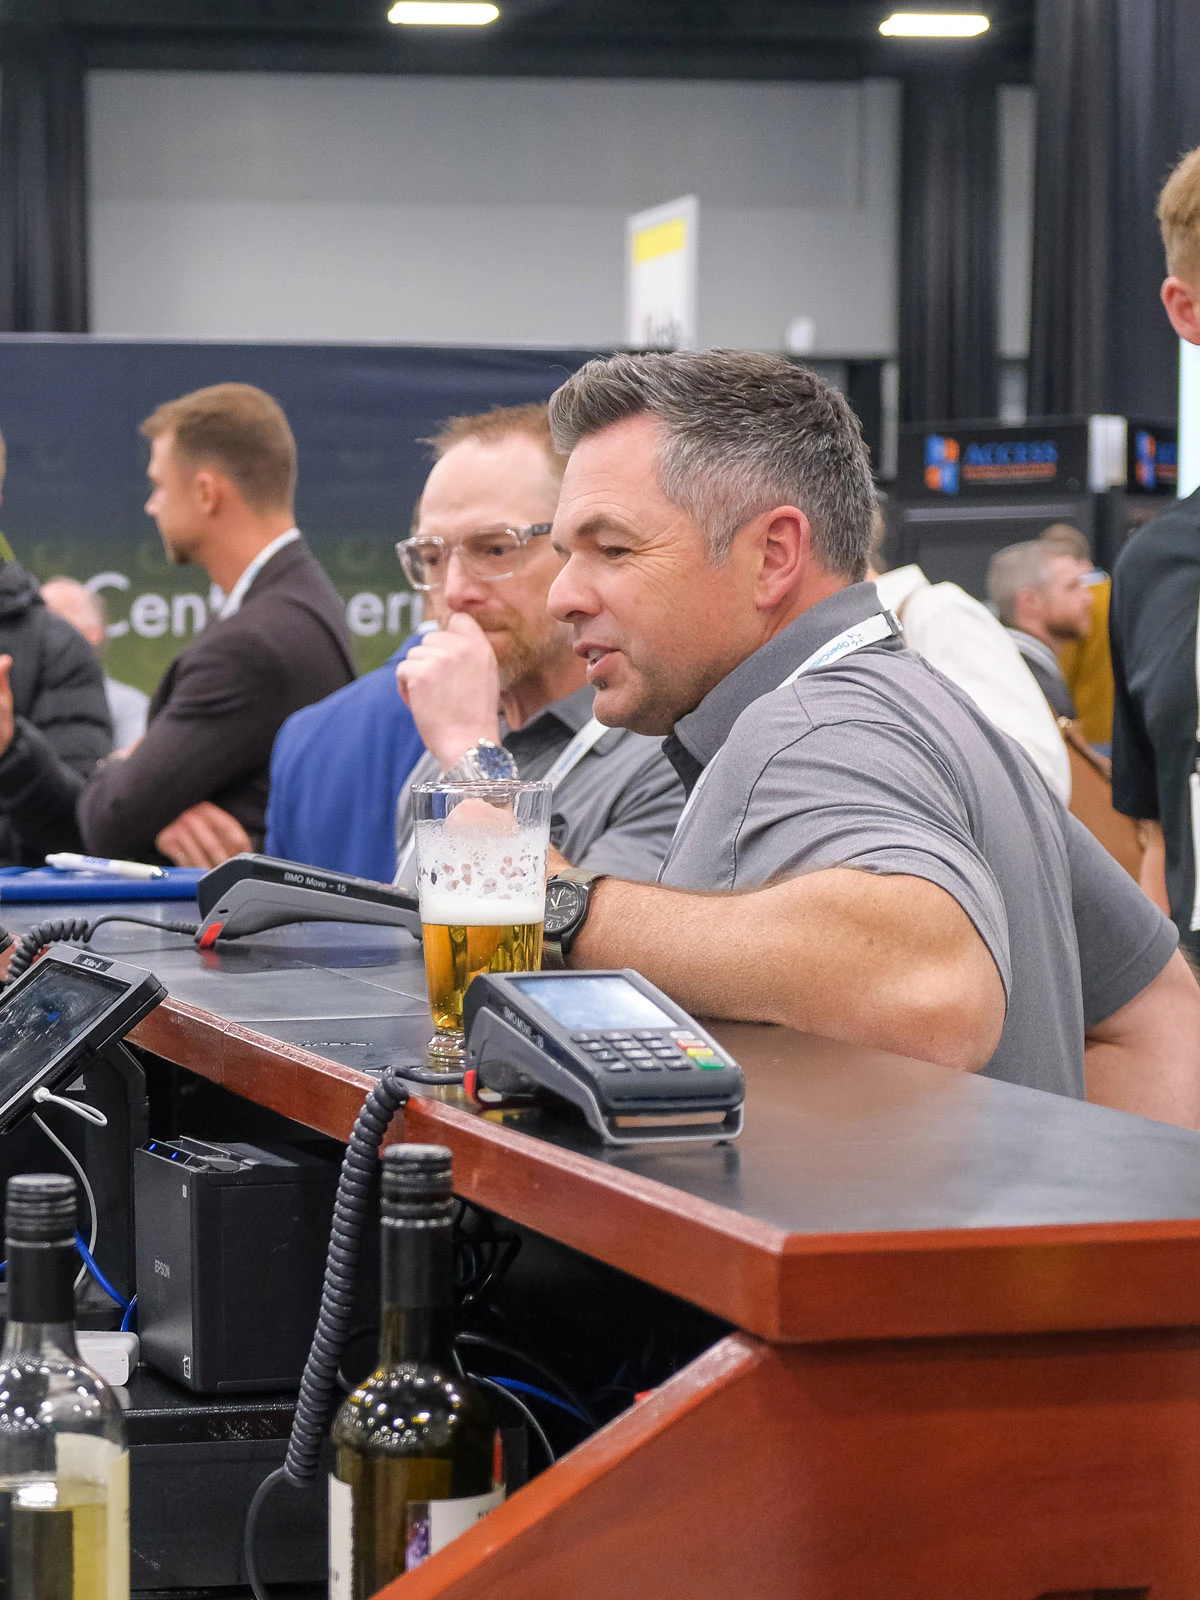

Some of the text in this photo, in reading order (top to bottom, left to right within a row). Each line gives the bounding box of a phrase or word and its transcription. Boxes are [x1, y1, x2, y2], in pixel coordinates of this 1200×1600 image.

[963, 440, 1058, 465] ACCESS
[284, 872, 305, 883] BMO
[306, 875, 327, 888] Move
[337, 884, 347, 893] 15
[154, 1259, 170, 1279] EPSON
